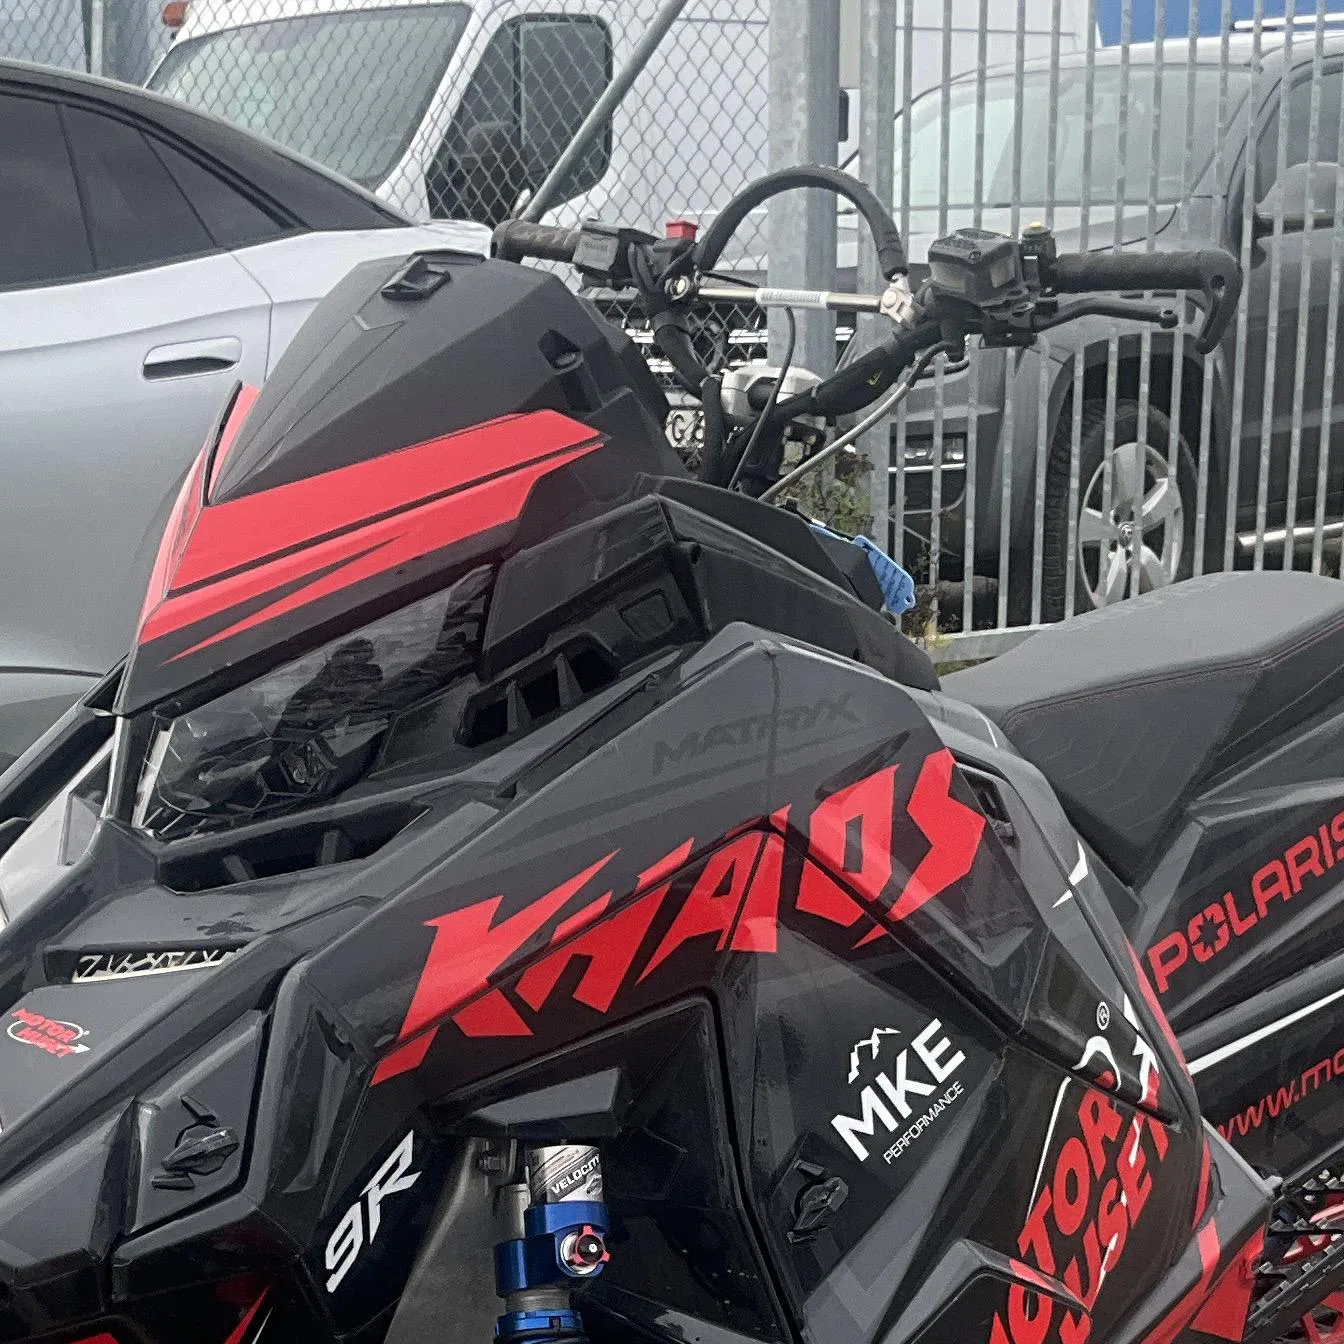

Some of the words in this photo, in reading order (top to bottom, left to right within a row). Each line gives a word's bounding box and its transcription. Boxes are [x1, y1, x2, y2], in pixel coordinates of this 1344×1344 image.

[653, 693, 861, 776] MATRYX
[370, 747, 986, 1086] KHAOS
[830, 1017, 966, 1162] MKE
[882, 1080, 965, 1165] PERFORMANCE
[325, 1129, 422, 1293] 9R
[551, 1153, 601, 1195] VELOCITY
